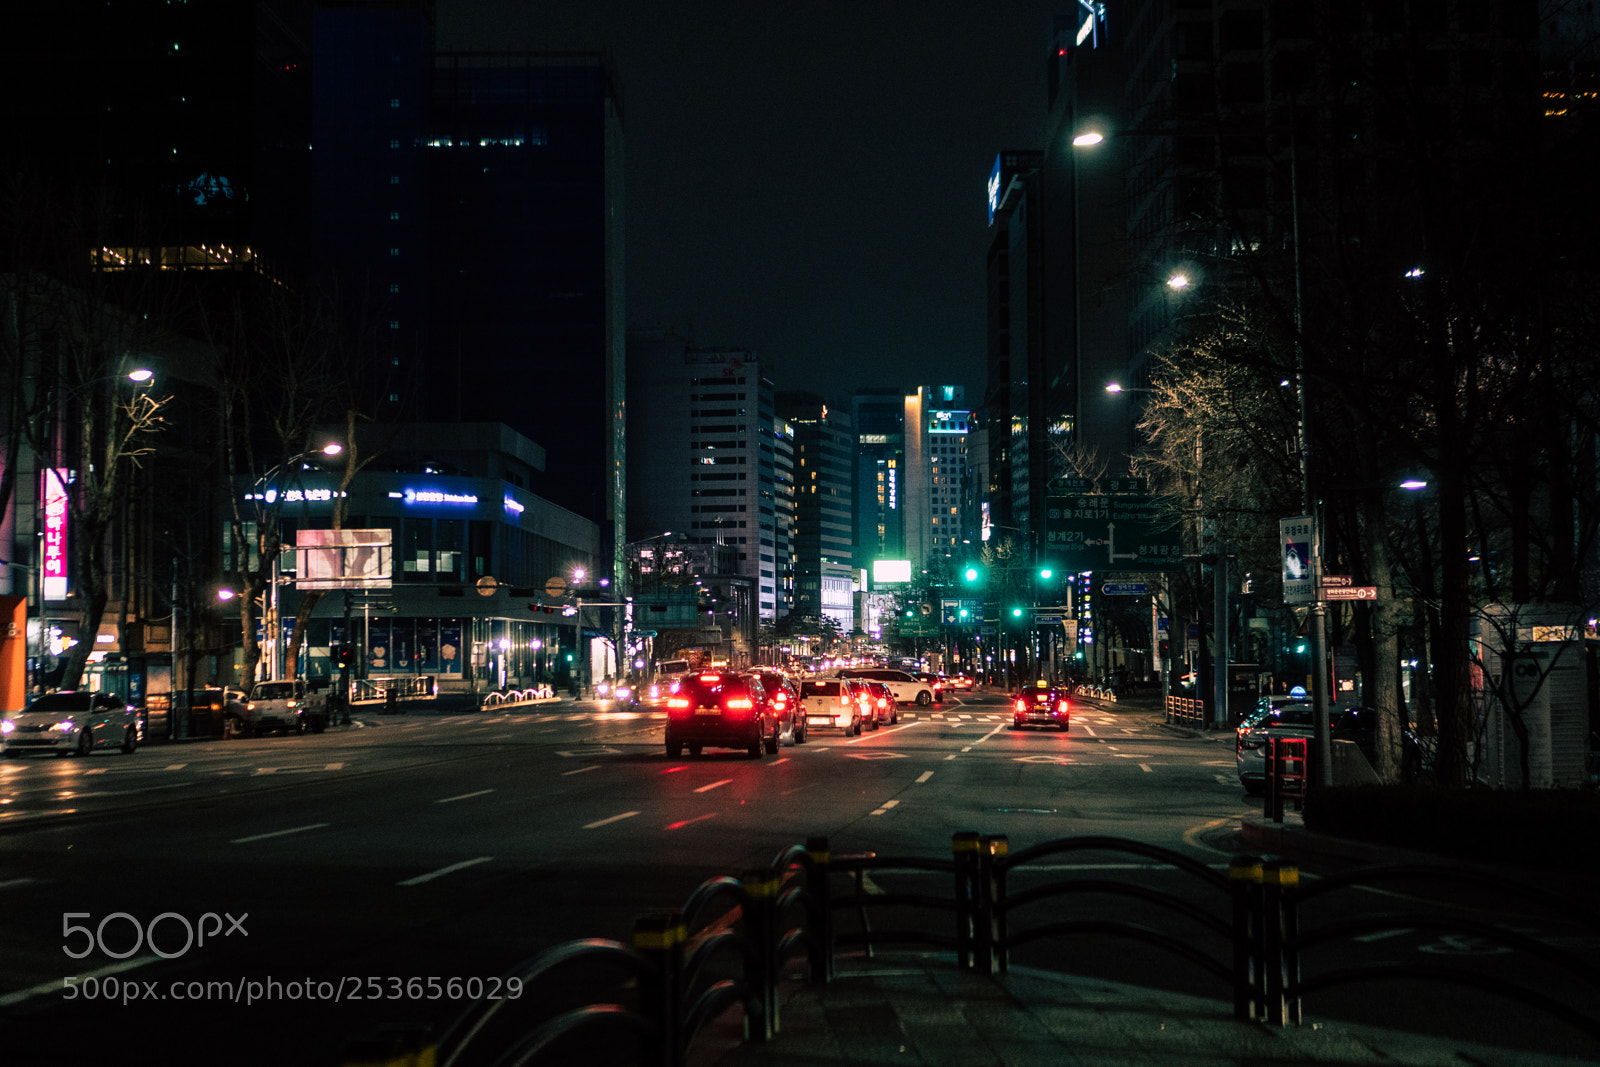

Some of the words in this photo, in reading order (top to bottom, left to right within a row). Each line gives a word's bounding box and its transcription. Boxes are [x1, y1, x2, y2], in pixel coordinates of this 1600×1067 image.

[1077, 497, 1110, 508] 숭례문
[1062, 508, 1109, 520] 을지로1가
[1047, 530, 1084, 542] 청계2가
[1138, 544, 1180, 555] 청계광장
